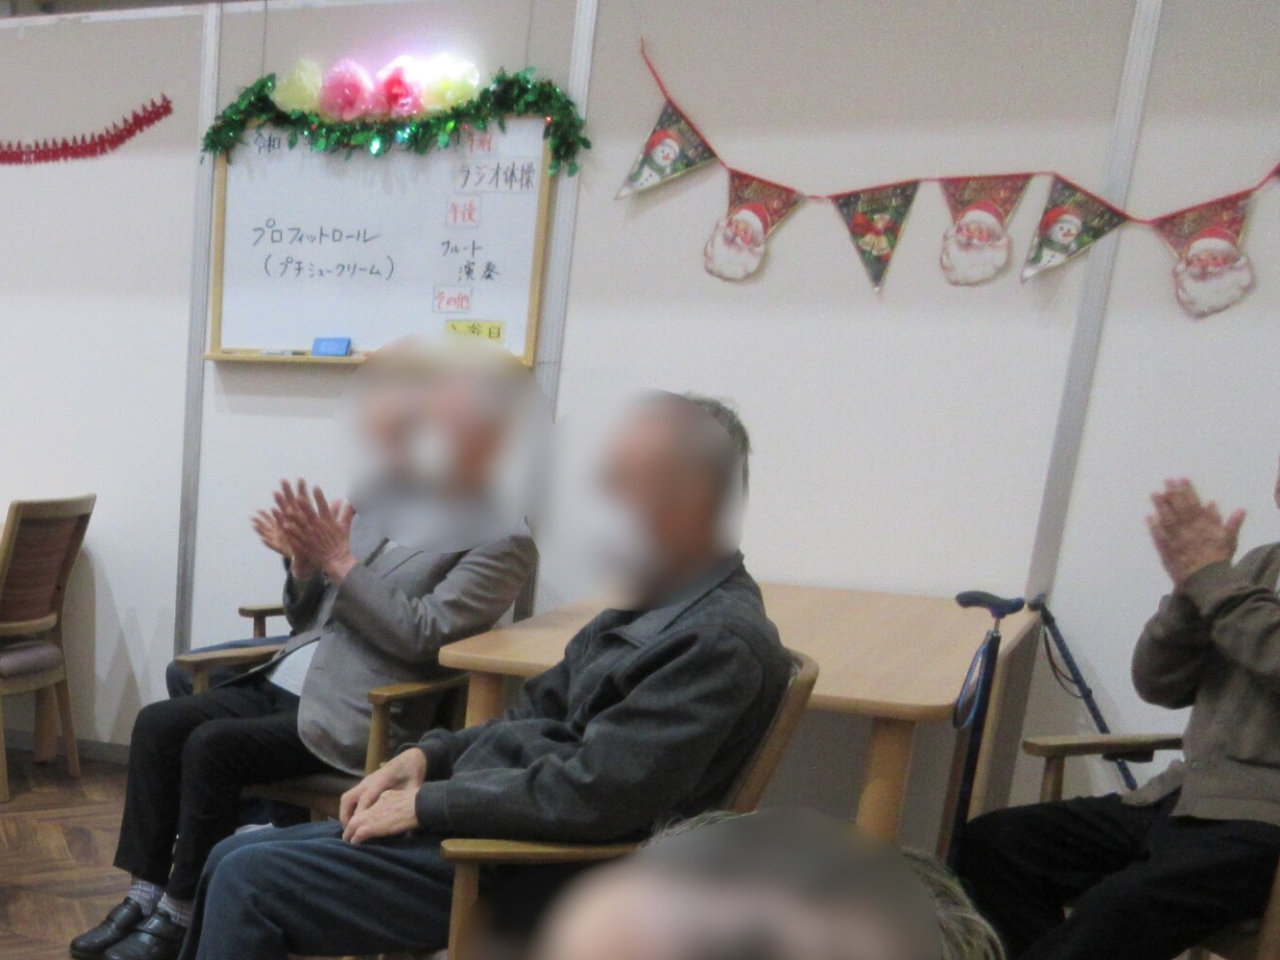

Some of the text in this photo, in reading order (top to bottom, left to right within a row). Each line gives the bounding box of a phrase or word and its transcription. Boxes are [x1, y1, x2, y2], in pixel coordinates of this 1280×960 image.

[460, 162, 535, 190] ラジオ体操
[450, 201, 477, 224] 午後
[252, 218, 381, 247] プロフィットロール
[441, 240, 482, 257] フルート
[458, 262, 500, 281] 演奏
[435, 291, 470, 310] その他
